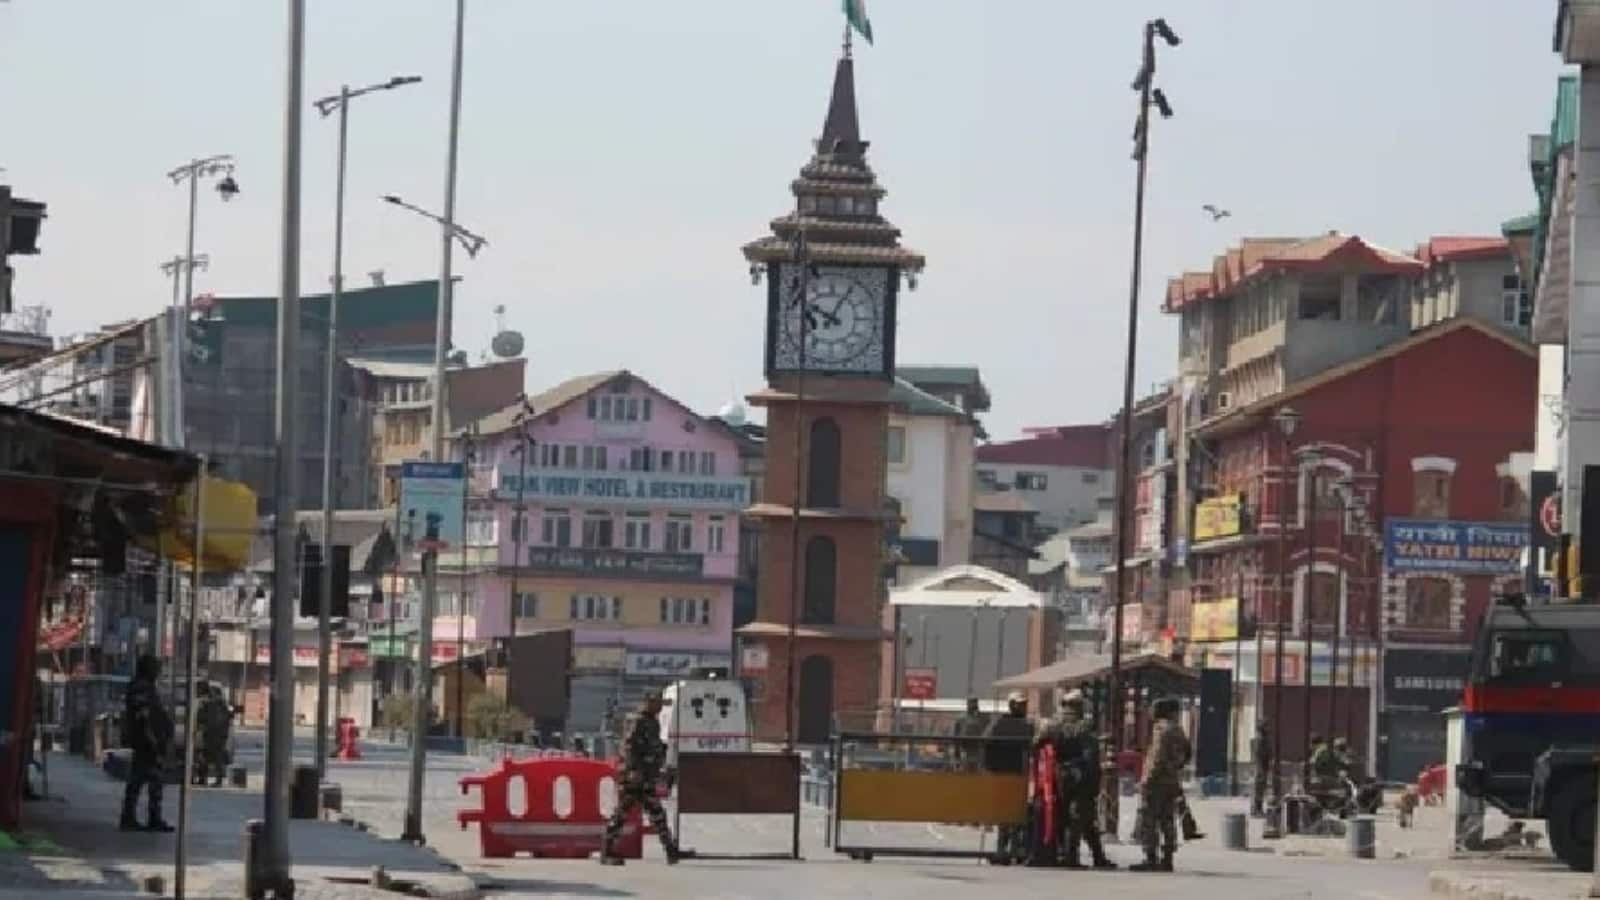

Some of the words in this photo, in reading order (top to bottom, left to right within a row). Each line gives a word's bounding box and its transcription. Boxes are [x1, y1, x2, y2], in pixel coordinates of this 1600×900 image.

[545, 476, 579, 495] VIEW
[584, 477, 630, 498] HOTEL
[650, 481, 746, 502] RESTAURANT
[1394, 543, 1460, 559] YATRI
